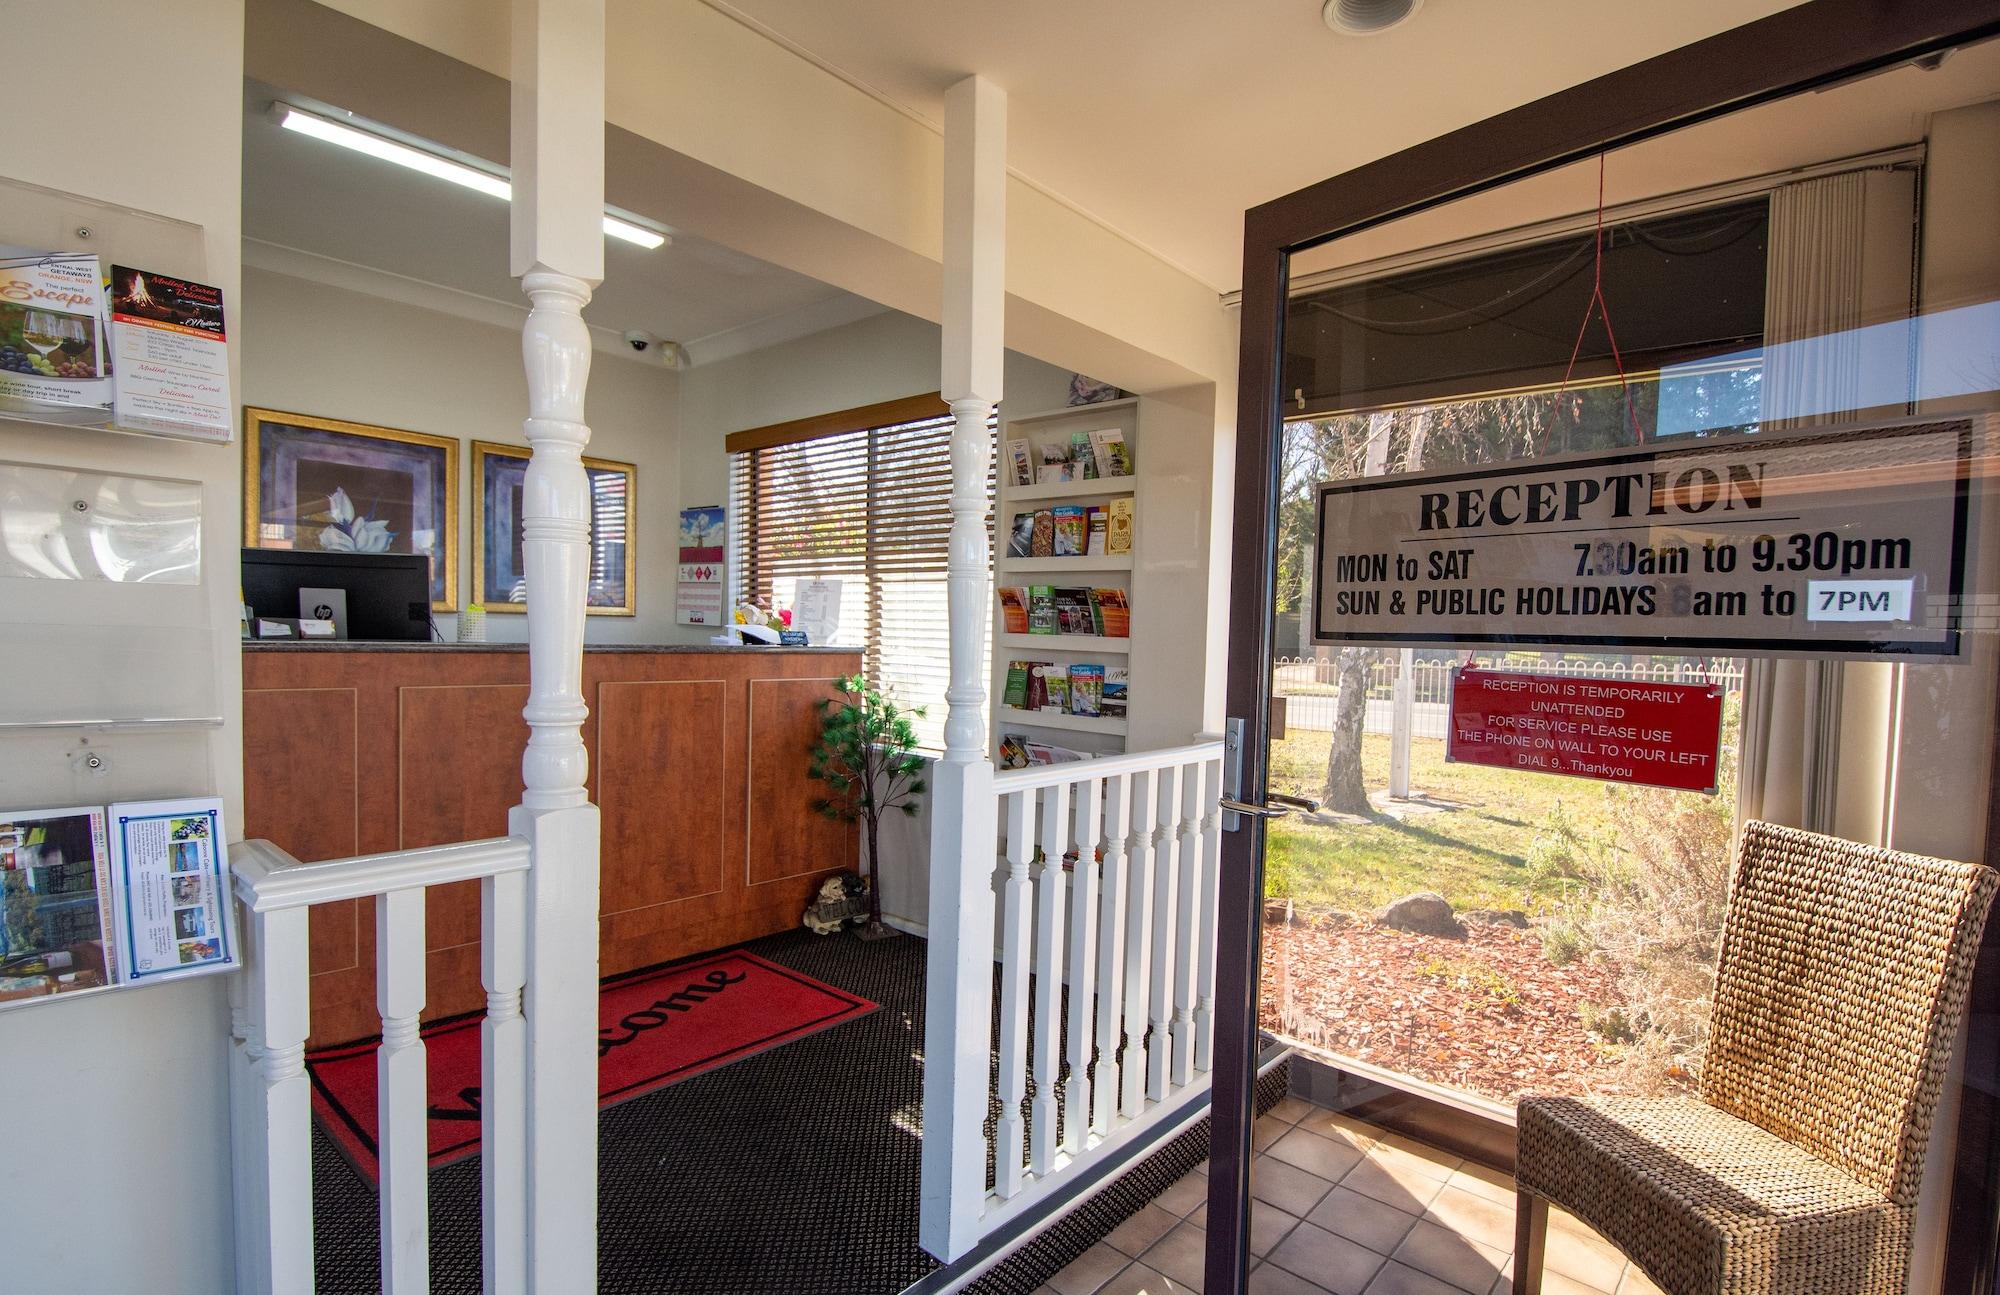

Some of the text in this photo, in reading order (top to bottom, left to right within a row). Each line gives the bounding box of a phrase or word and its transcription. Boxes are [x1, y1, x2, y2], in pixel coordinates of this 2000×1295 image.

[45, 282, 59, 290] The
[50, 268, 92, 278] GETAWAYS
[0, 280, 94, 308] Escape
[1418, 462, 1767, 531] RECEPTION
[1337, 531, 1911, 582] MON to SAT 7.30am to 9.30pm
[1336, 590, 1380, 615] SUN
[1389, 589, 1406, 615] &
[1416, 588, 1505, 615] PUBLIC
[1516, 585, 1657, 616] HOLIDAYS
[1761, 584, 1795, 616] to
[1819, 590, 1890, 612] 7PM
[316, 606, 332, 621] hp
[1483, 679, 1685, 704] RECEPTION IS TEMPORARILY
[1531, 701, 1625, 719] UNATTENDED
[1488, 715, 1672, 743] FOR SERVICE PLEASE USE
[1457, 729, 1709, 767] THE PHONE ON WALL TO YOUR LEFT
[1518, 753, 1547, 768] DIAL
